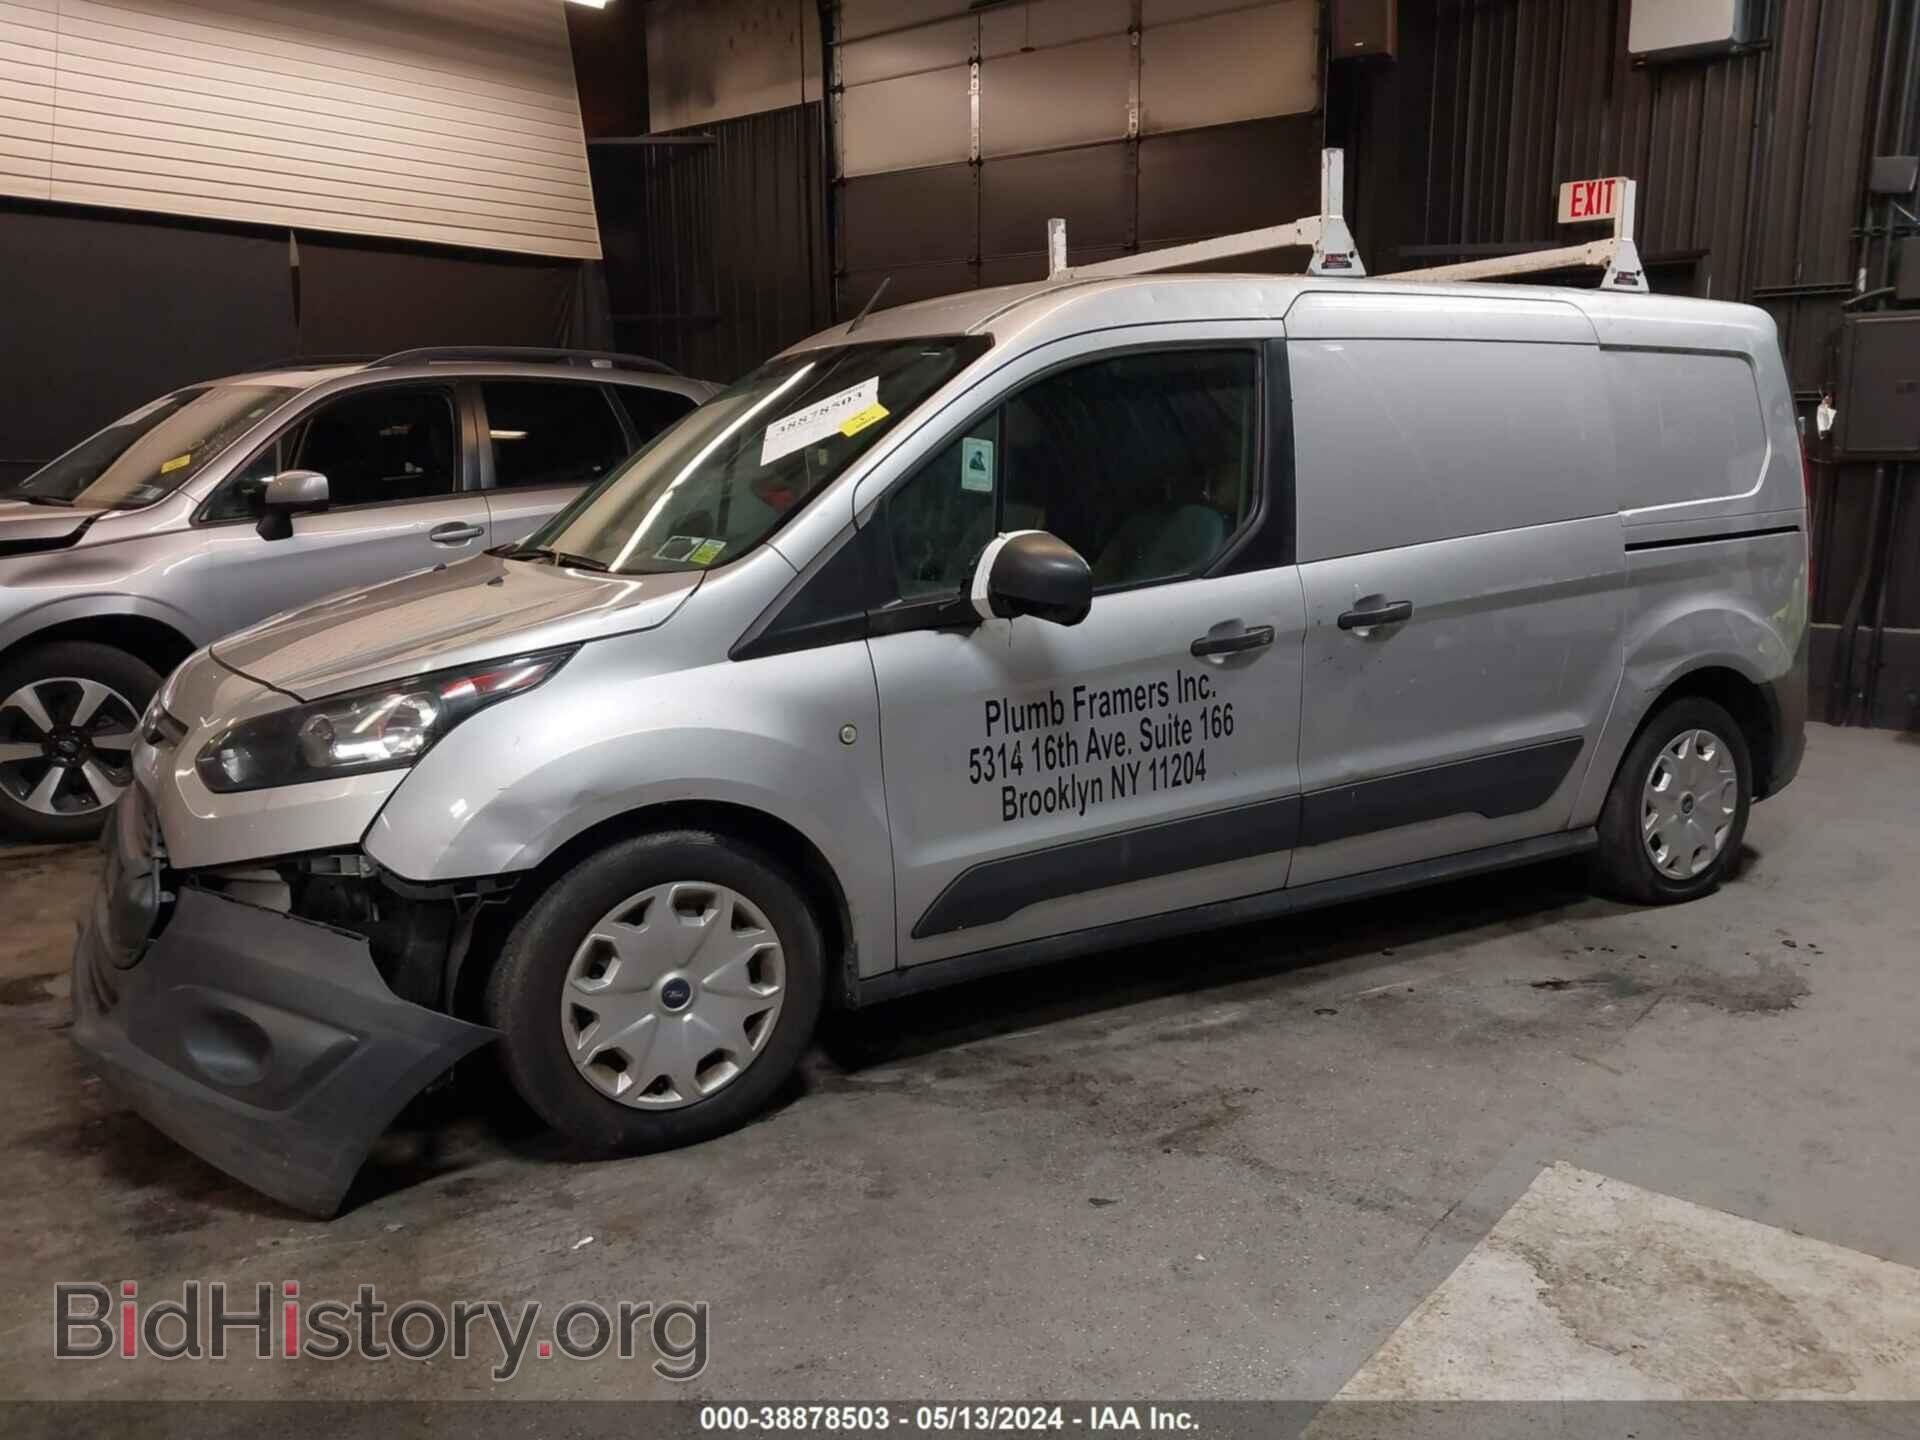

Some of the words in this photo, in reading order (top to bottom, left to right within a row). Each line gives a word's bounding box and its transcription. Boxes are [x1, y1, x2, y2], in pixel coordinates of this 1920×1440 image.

[1571, 180, 1615, 217] EXIT
[985, 690, 1065, 737] Plumb
[1072, 680, 1169, 722] Framers
[1176, 669, 1216, 703] Inc.
[969, 740, 1023, 785] 5314
[1031, 731, 1079, 772] 16th
[1086, 727, 1132, 763] Ave.
[1139, 713, 1192, 752] Suite
[1199, 703, 1234, 740] 166
[1001, 774, 1103, 822] Brooklyn
[1111, 761, 1141, 799] NY
[1149, 749, 1206, 791] 11204
